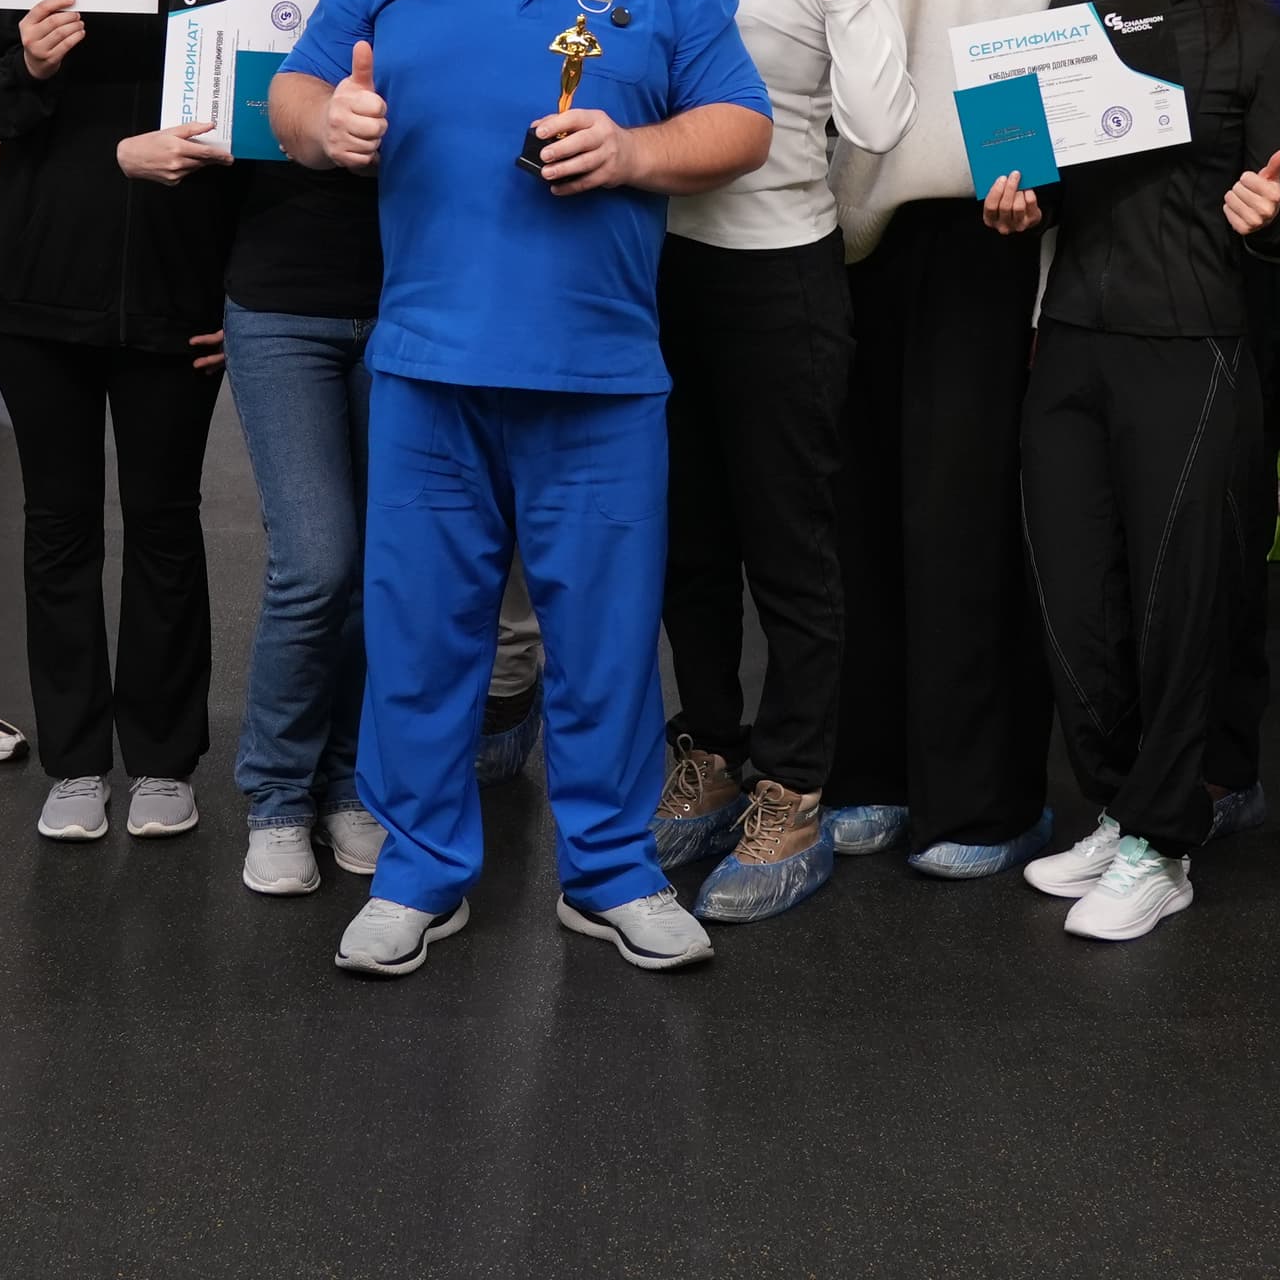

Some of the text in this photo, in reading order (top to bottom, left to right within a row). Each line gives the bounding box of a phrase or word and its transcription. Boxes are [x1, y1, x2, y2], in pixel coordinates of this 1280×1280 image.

[1122, 14, 1164, 28] CHAMPION
[1120, 22, 1153, 35] SCHOOL
[969, 24, 1089, 56] СЕРТИФИКАТ
[181, 19, 198, 125] ЕРТИФИКАТ
[1027, 62, 1050, 75] ДИНАРА
